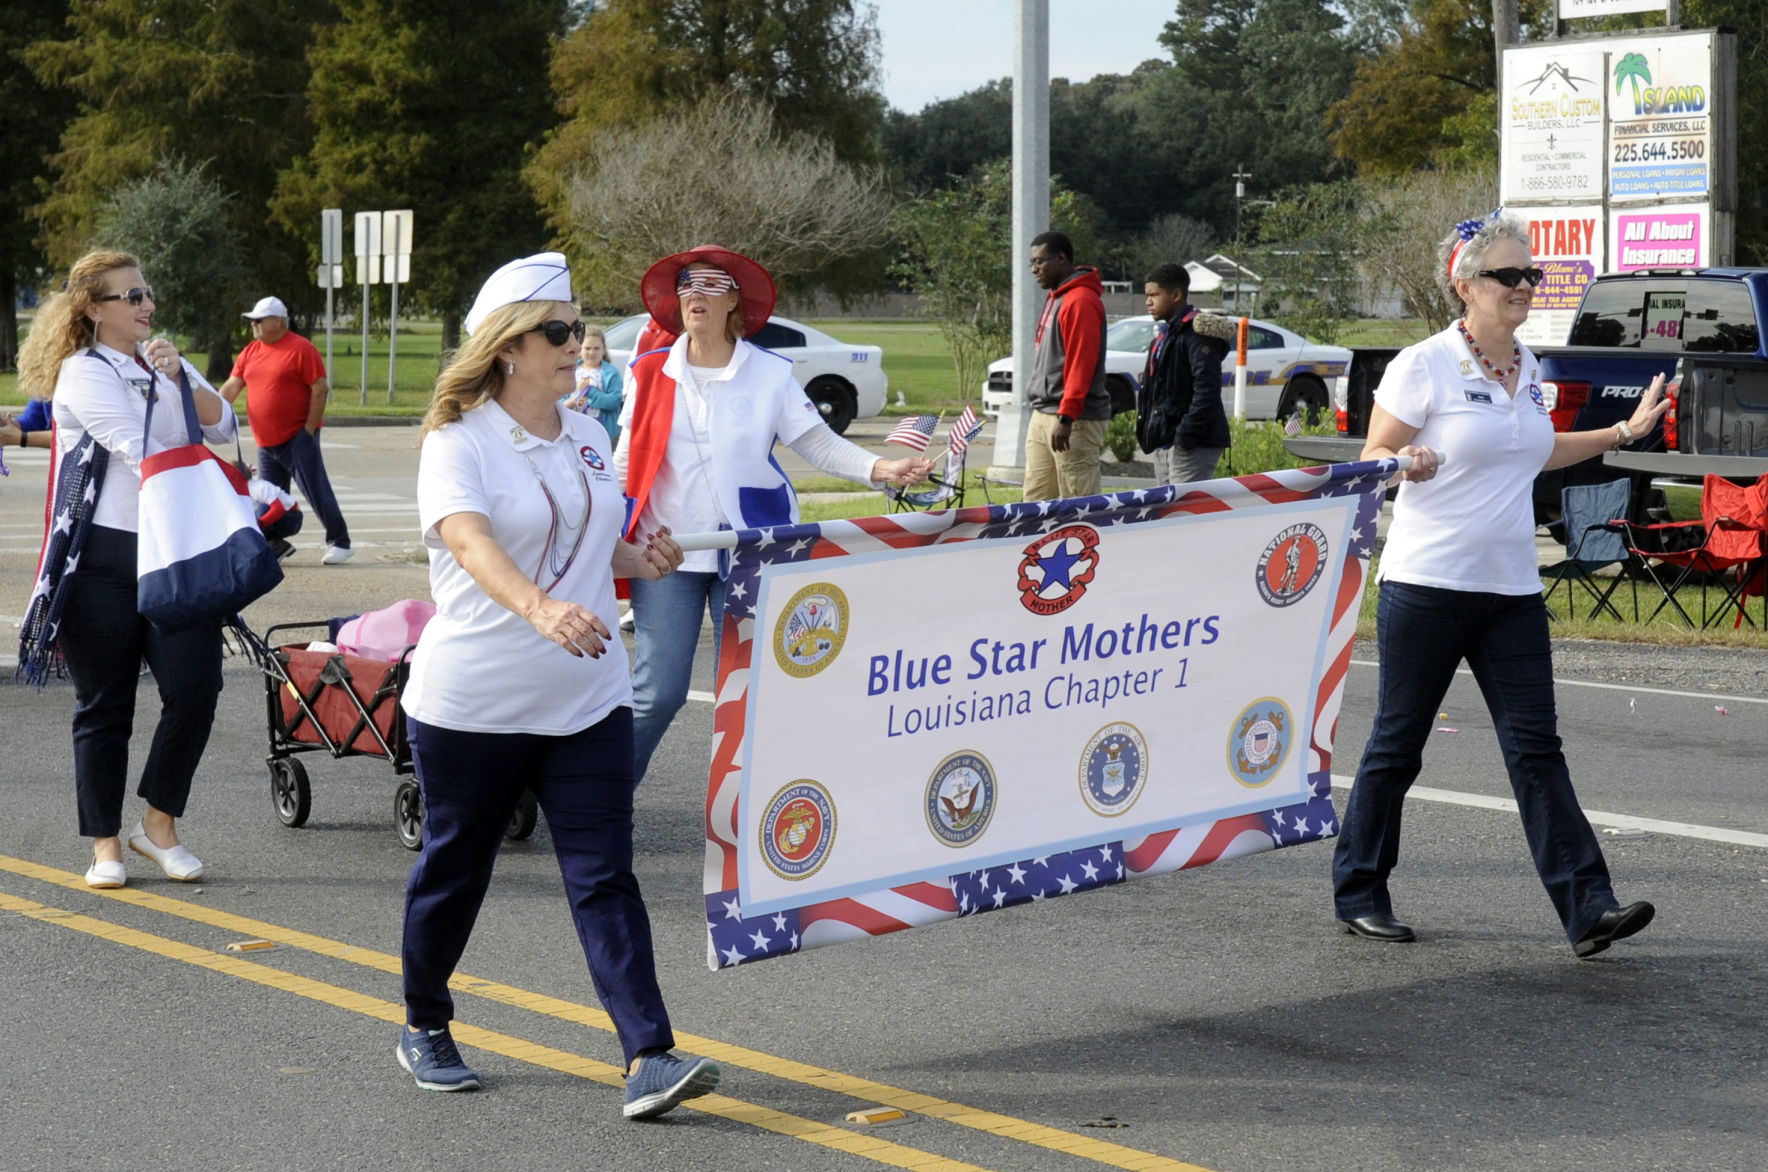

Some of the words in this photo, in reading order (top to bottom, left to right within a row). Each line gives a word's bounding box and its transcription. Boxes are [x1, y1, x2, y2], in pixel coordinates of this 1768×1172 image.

[1634, 85, 1705, 115] ISLAND
[1567, 119, 1581, 128] LLC
[1614, 124, 1649, 135] FINANCIAL
[1692, 120, 1706, 131] LLC
[1614, 140, 1705, 162] 225.644.5500
[1642, 168, 1661, 178] LOANS
[1687, 167, 1705, 176] LOANS
[1614, 182, 1629, 191] AUTO
[1630, 181, 1649, 190] LOANS
[1685, 179, 1704, 188] LOANS
[1528, 219, 1595, 256] OTARY
[1624, 222, 1646, 241] All
[1649, 220, 1694, 241] About
[1622, 246, 1696, 266] Insurance
[1546, 274, 1571, 285] TITLE
[851, 352, 868, 361] 911
[1258, 523, 1307, 566] NATIONAL
[1307, 525, 1328, 562] GUARD
[1030, 595, 1073, 612] MOTHER
[867, 650, 952, 697] Blue
[967, 638, 1047, 680] Star
[1060, 614, 1220, 665] Mothers
[887, 688, 1031, 738] Louisiana
[1044, 667, 1162, 708] Chapter
[1174, 657, 1188, 688] 1
